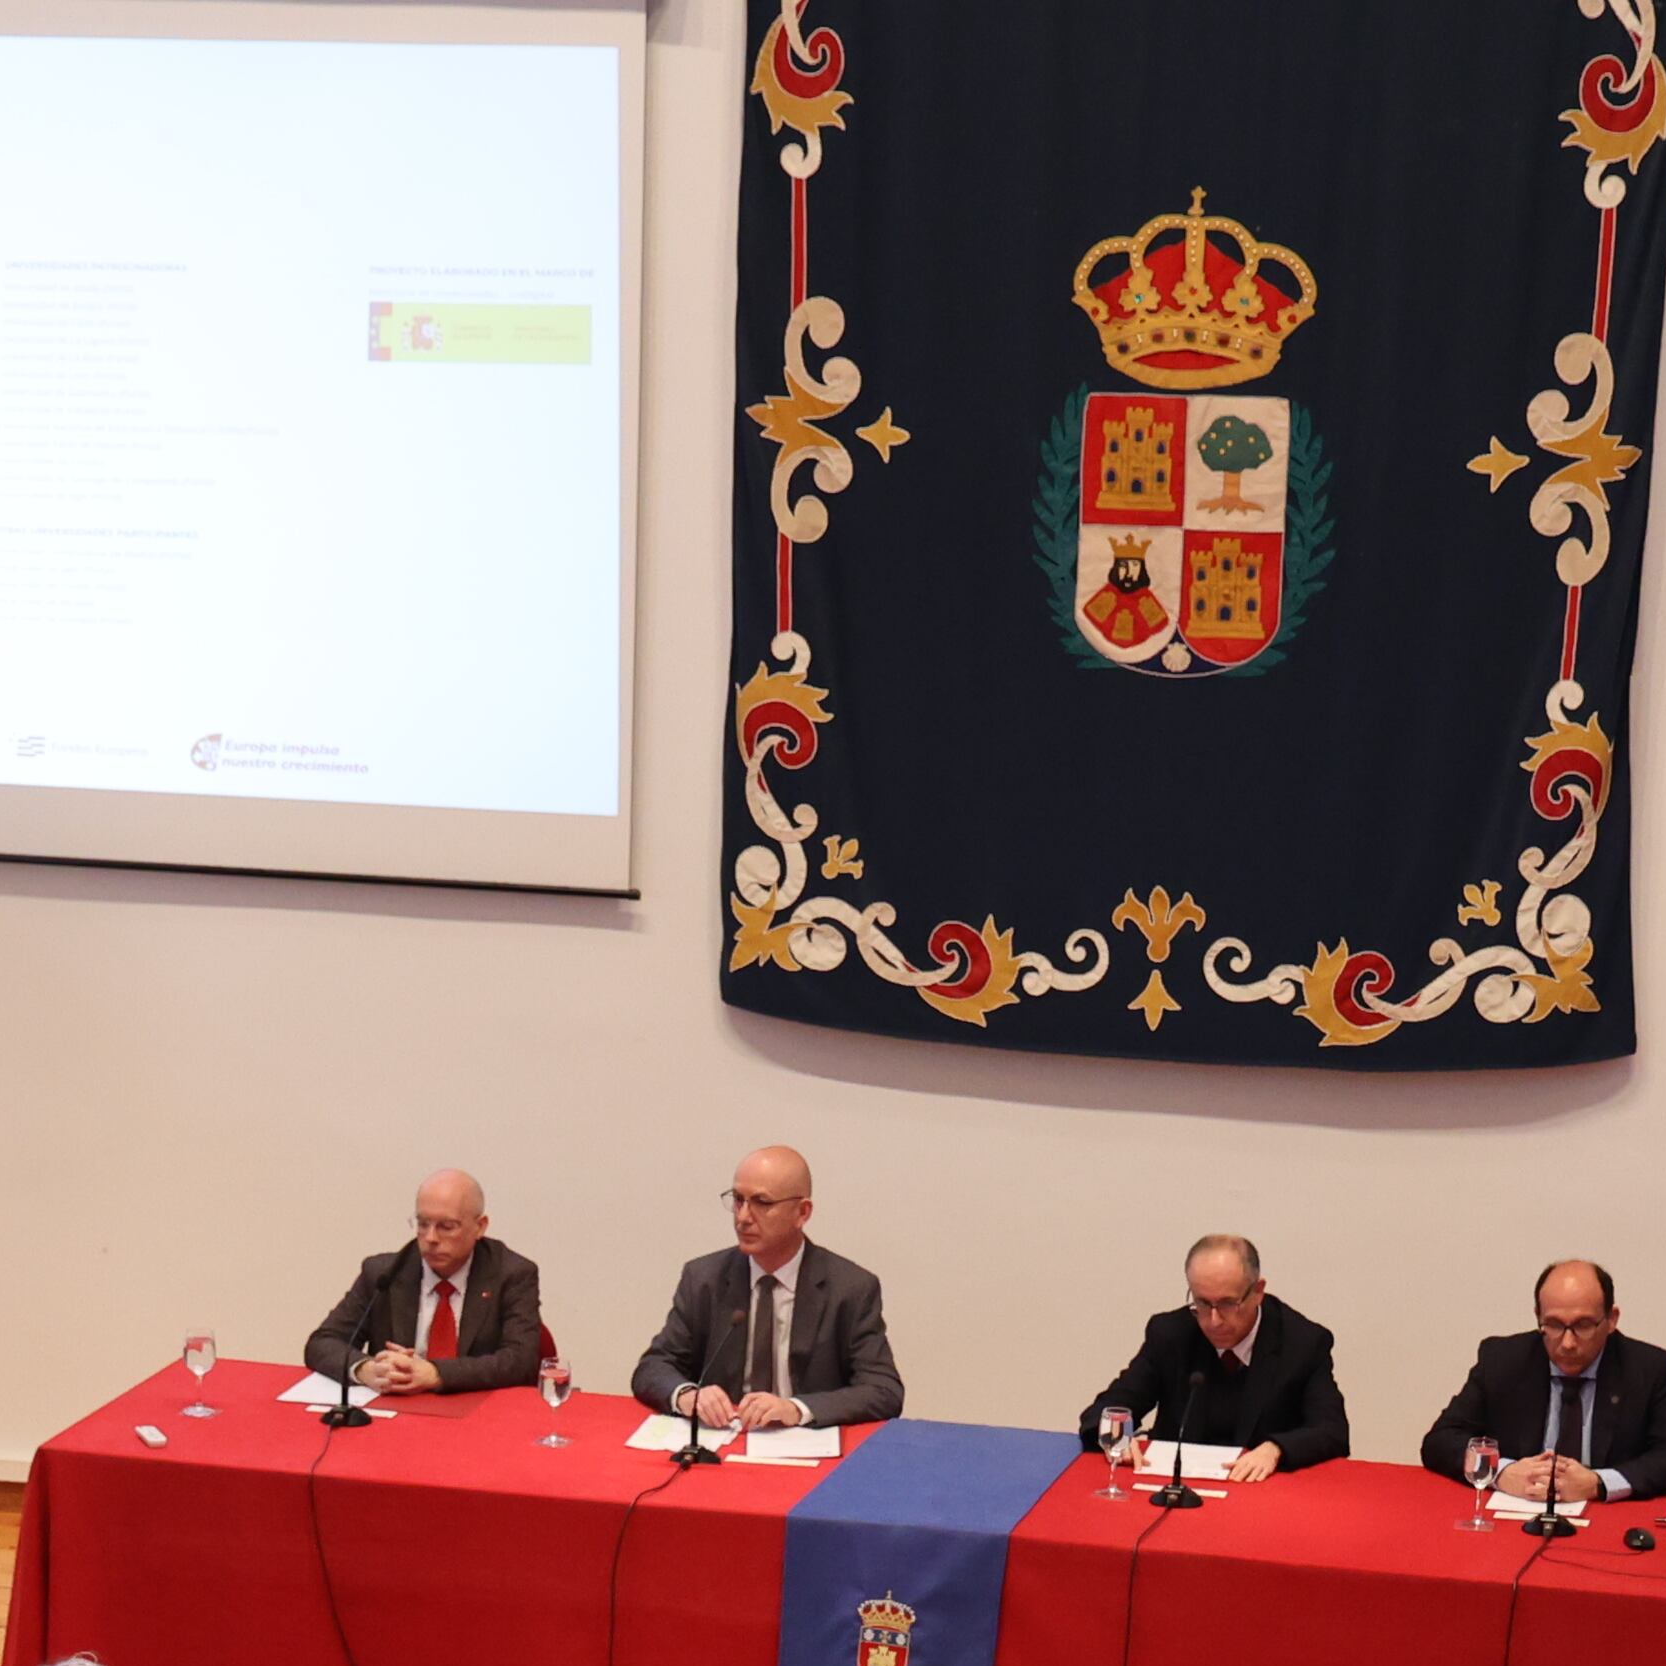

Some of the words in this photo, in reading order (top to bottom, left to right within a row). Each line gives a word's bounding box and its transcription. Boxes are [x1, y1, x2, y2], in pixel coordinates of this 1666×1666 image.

[224, 739, 278, 754] Europa
[282, 741, 340, 757] impulsa
[221, 756, 276, 769] nuestro
[280, 760, 369, 774] crecimiento
